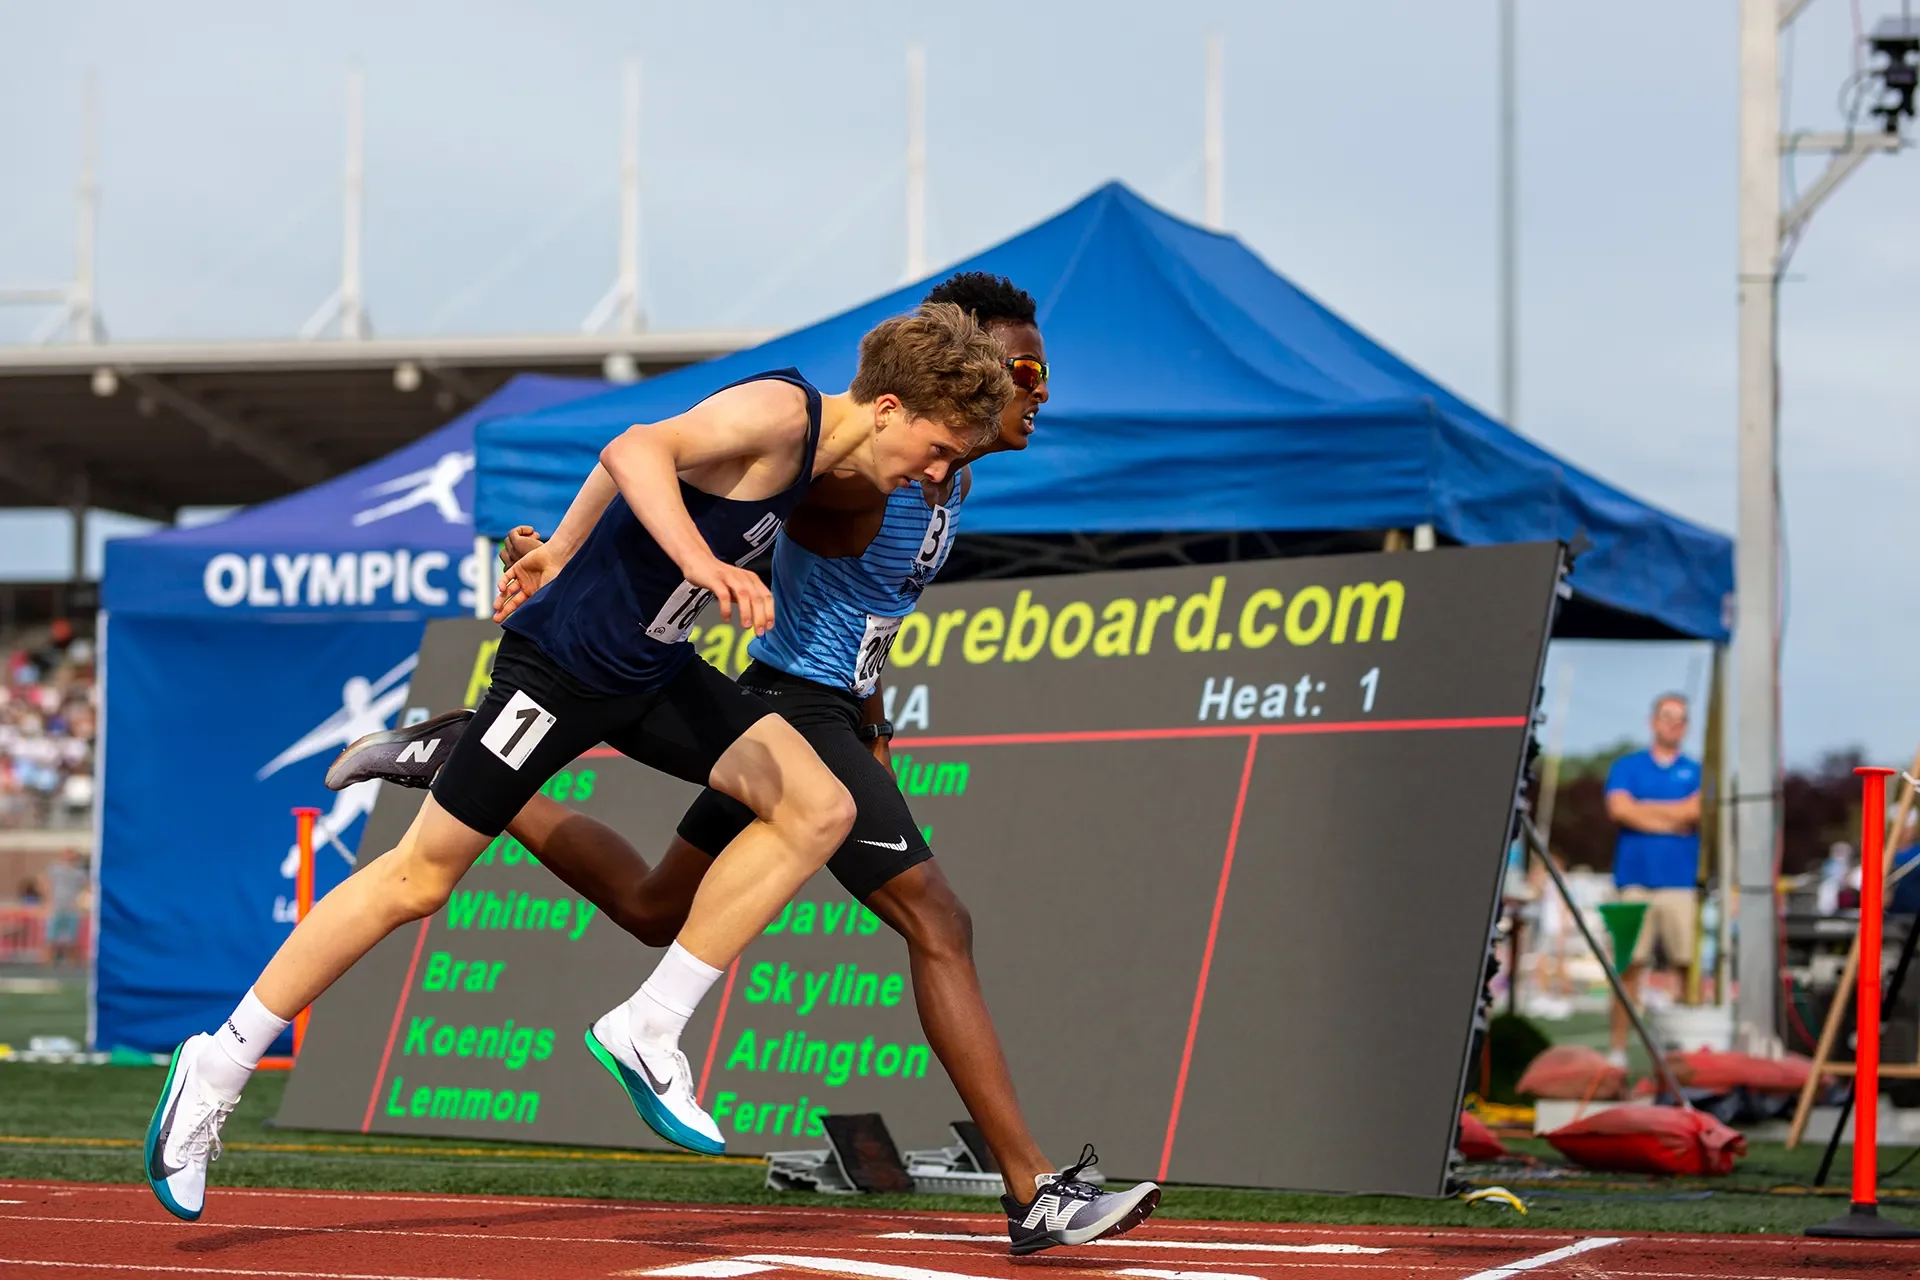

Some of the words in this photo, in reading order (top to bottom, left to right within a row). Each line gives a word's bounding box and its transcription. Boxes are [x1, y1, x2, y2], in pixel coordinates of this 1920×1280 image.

[921, 509, 946, 562] 3
[203, 549, 450, 607] OLYMPIC
[1199, 671, 1326, 721] Heat:
[1360, 666, 1382, 713] 1
[500, 707, 541, 758] 1
[447, 890, 597, 941] Whitney
[422, 951, 507, 992] Brar
[744, 961, 904, 1016] Skyline
[403, 1015, 557, 1070] Koenigs
[726, 1027, 931, 1087] Arlington
[385, 1076, 541, 1124] Lemmon
[710, 1089, 831, 1138] Ferris
